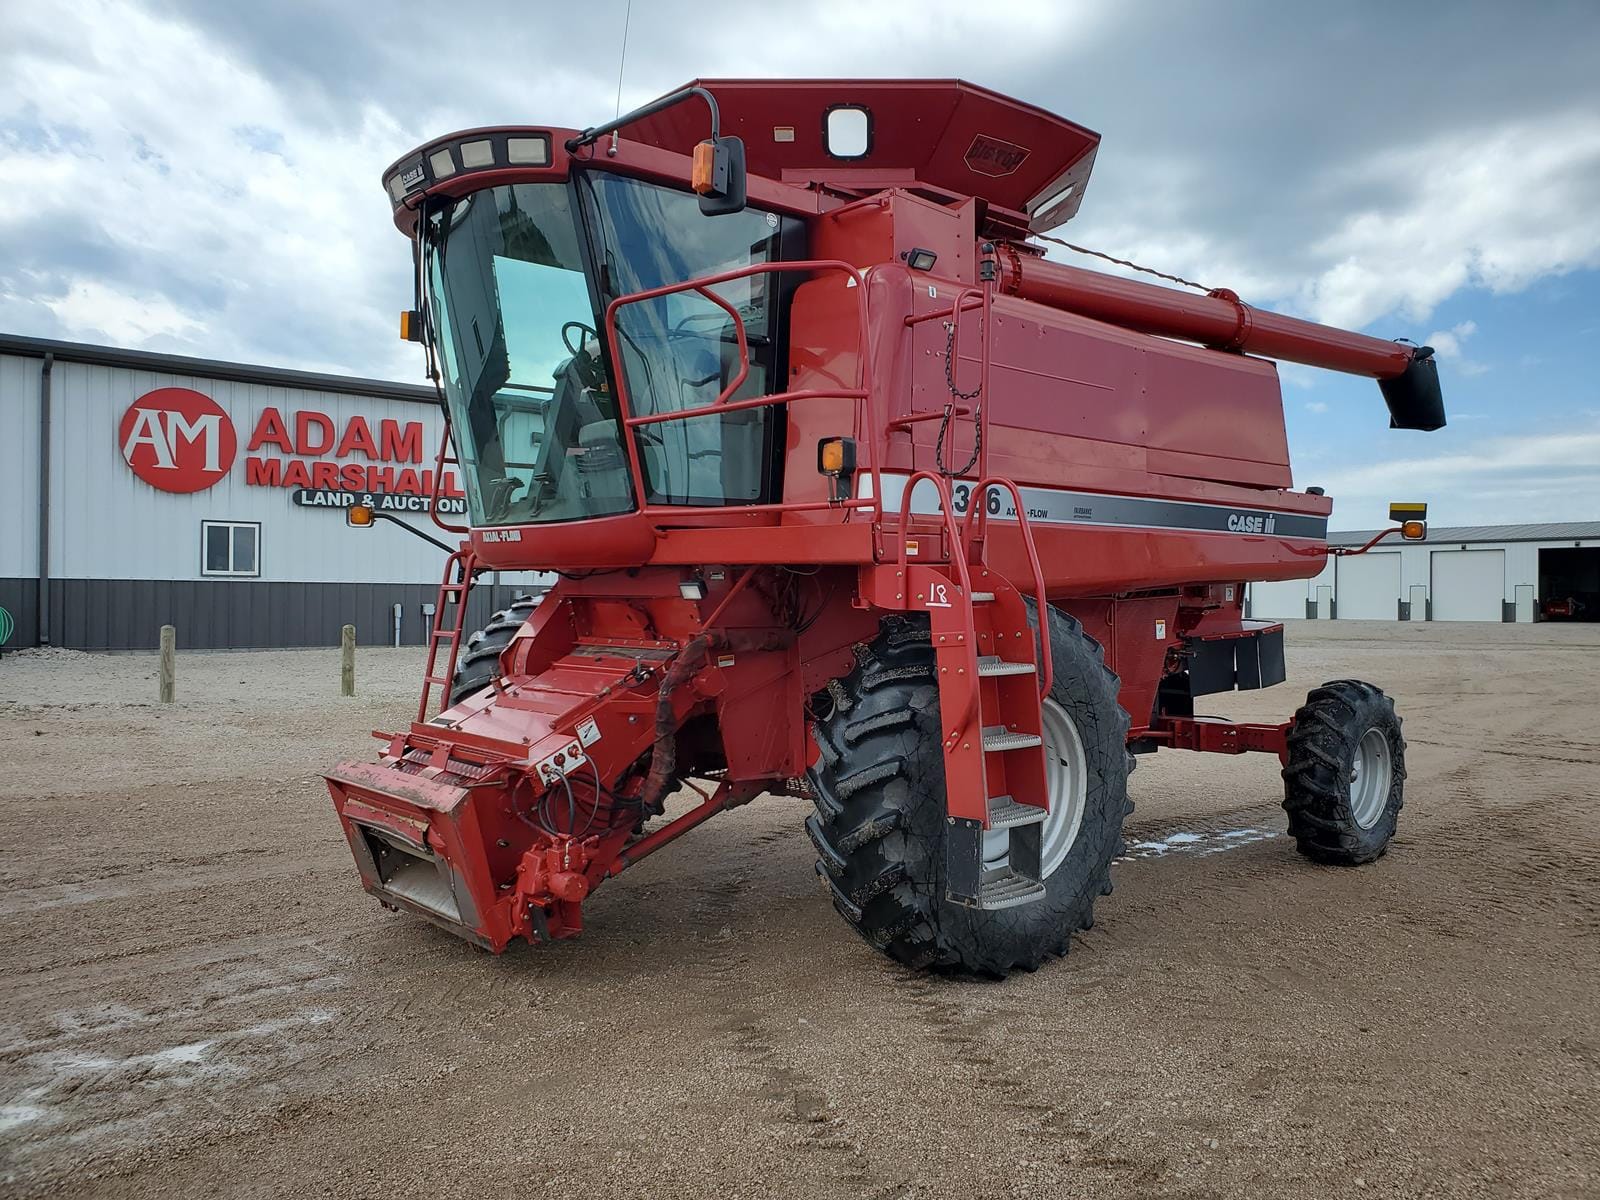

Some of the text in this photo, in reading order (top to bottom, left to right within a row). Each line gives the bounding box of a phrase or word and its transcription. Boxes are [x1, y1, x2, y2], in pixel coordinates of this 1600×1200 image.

[122, 407, 223, 472] AM
[247, 407, 423, 464] ADAM
[246, 457, 465, 497] MARSHALL
[301, 490, 464, 512] LAND & AUCTON
[1227, 513, 1263, 533] CASE
[930, 582, 947, 604] 18
